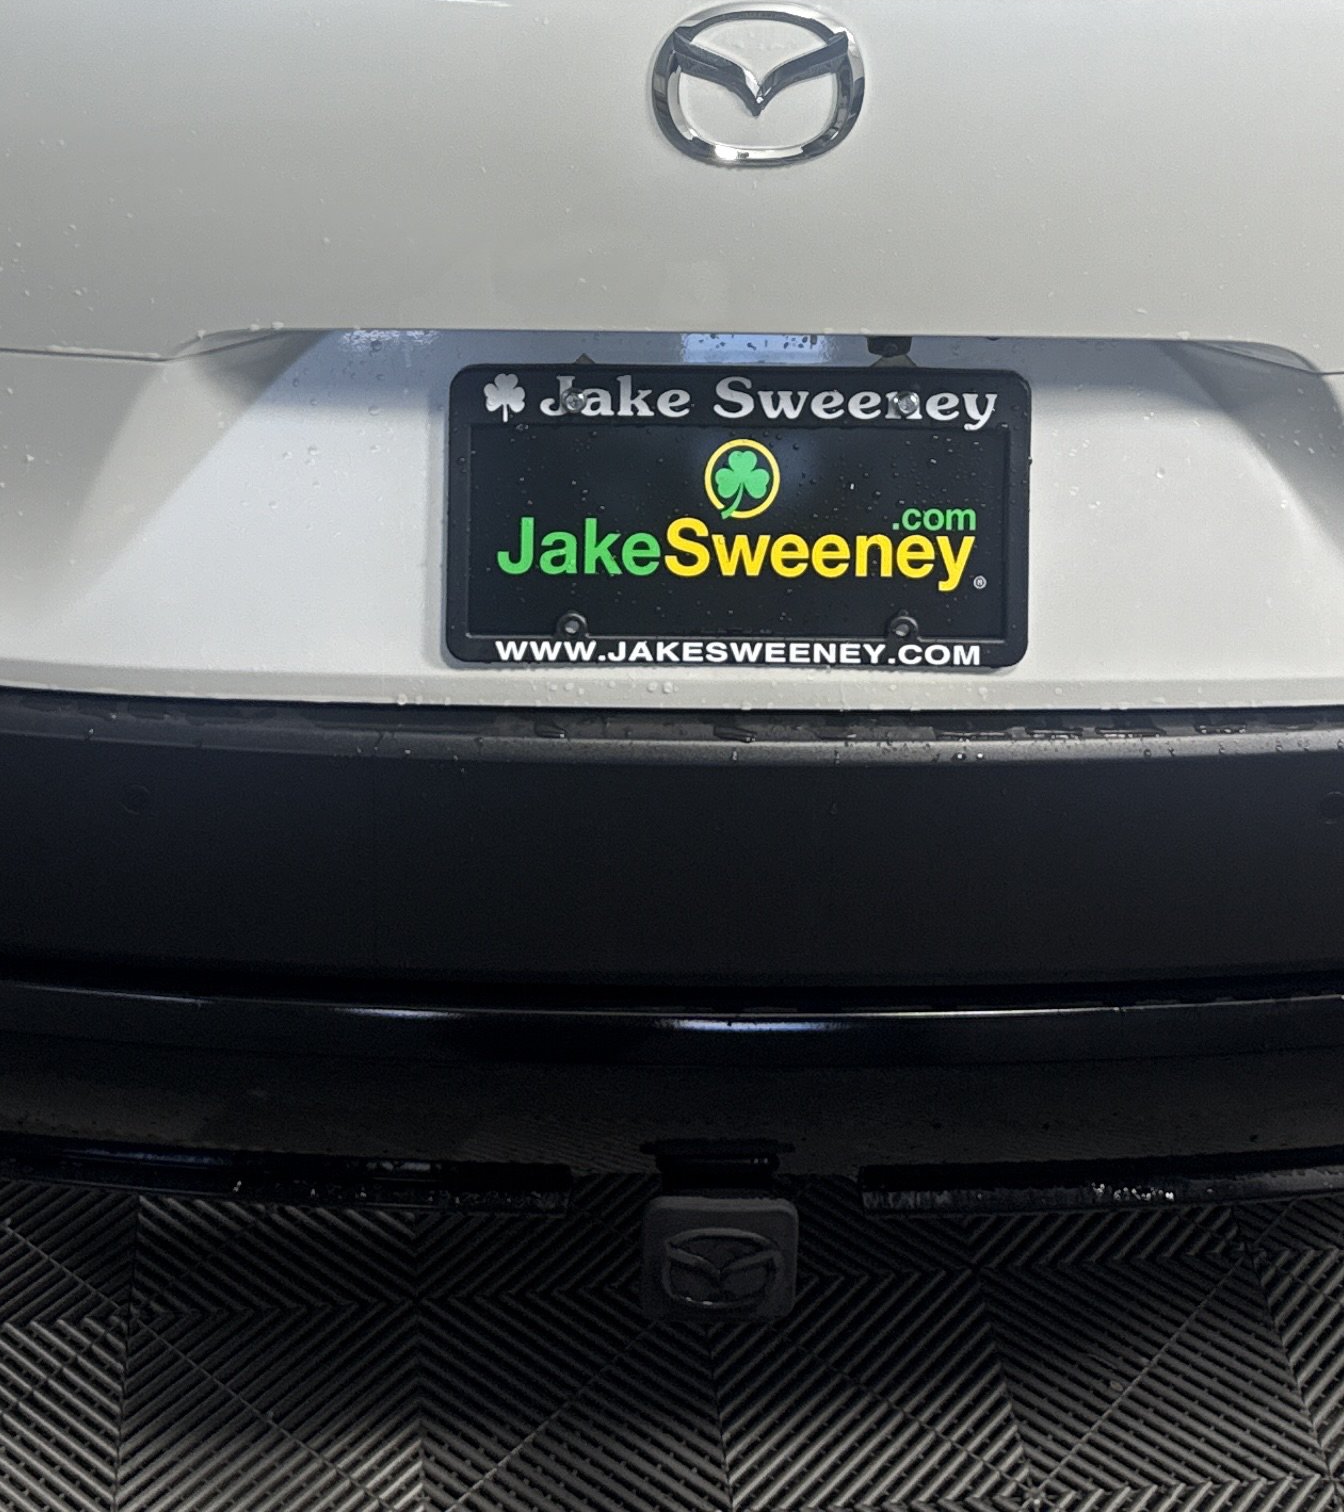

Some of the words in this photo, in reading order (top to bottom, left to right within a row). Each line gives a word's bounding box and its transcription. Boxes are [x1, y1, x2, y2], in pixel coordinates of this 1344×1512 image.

[540, 374, 691, 418] Jake
[713, 375, 998, 431] Sweeney
[495, 639, 981, 666] WWW.JAKESWEENEY.COM
